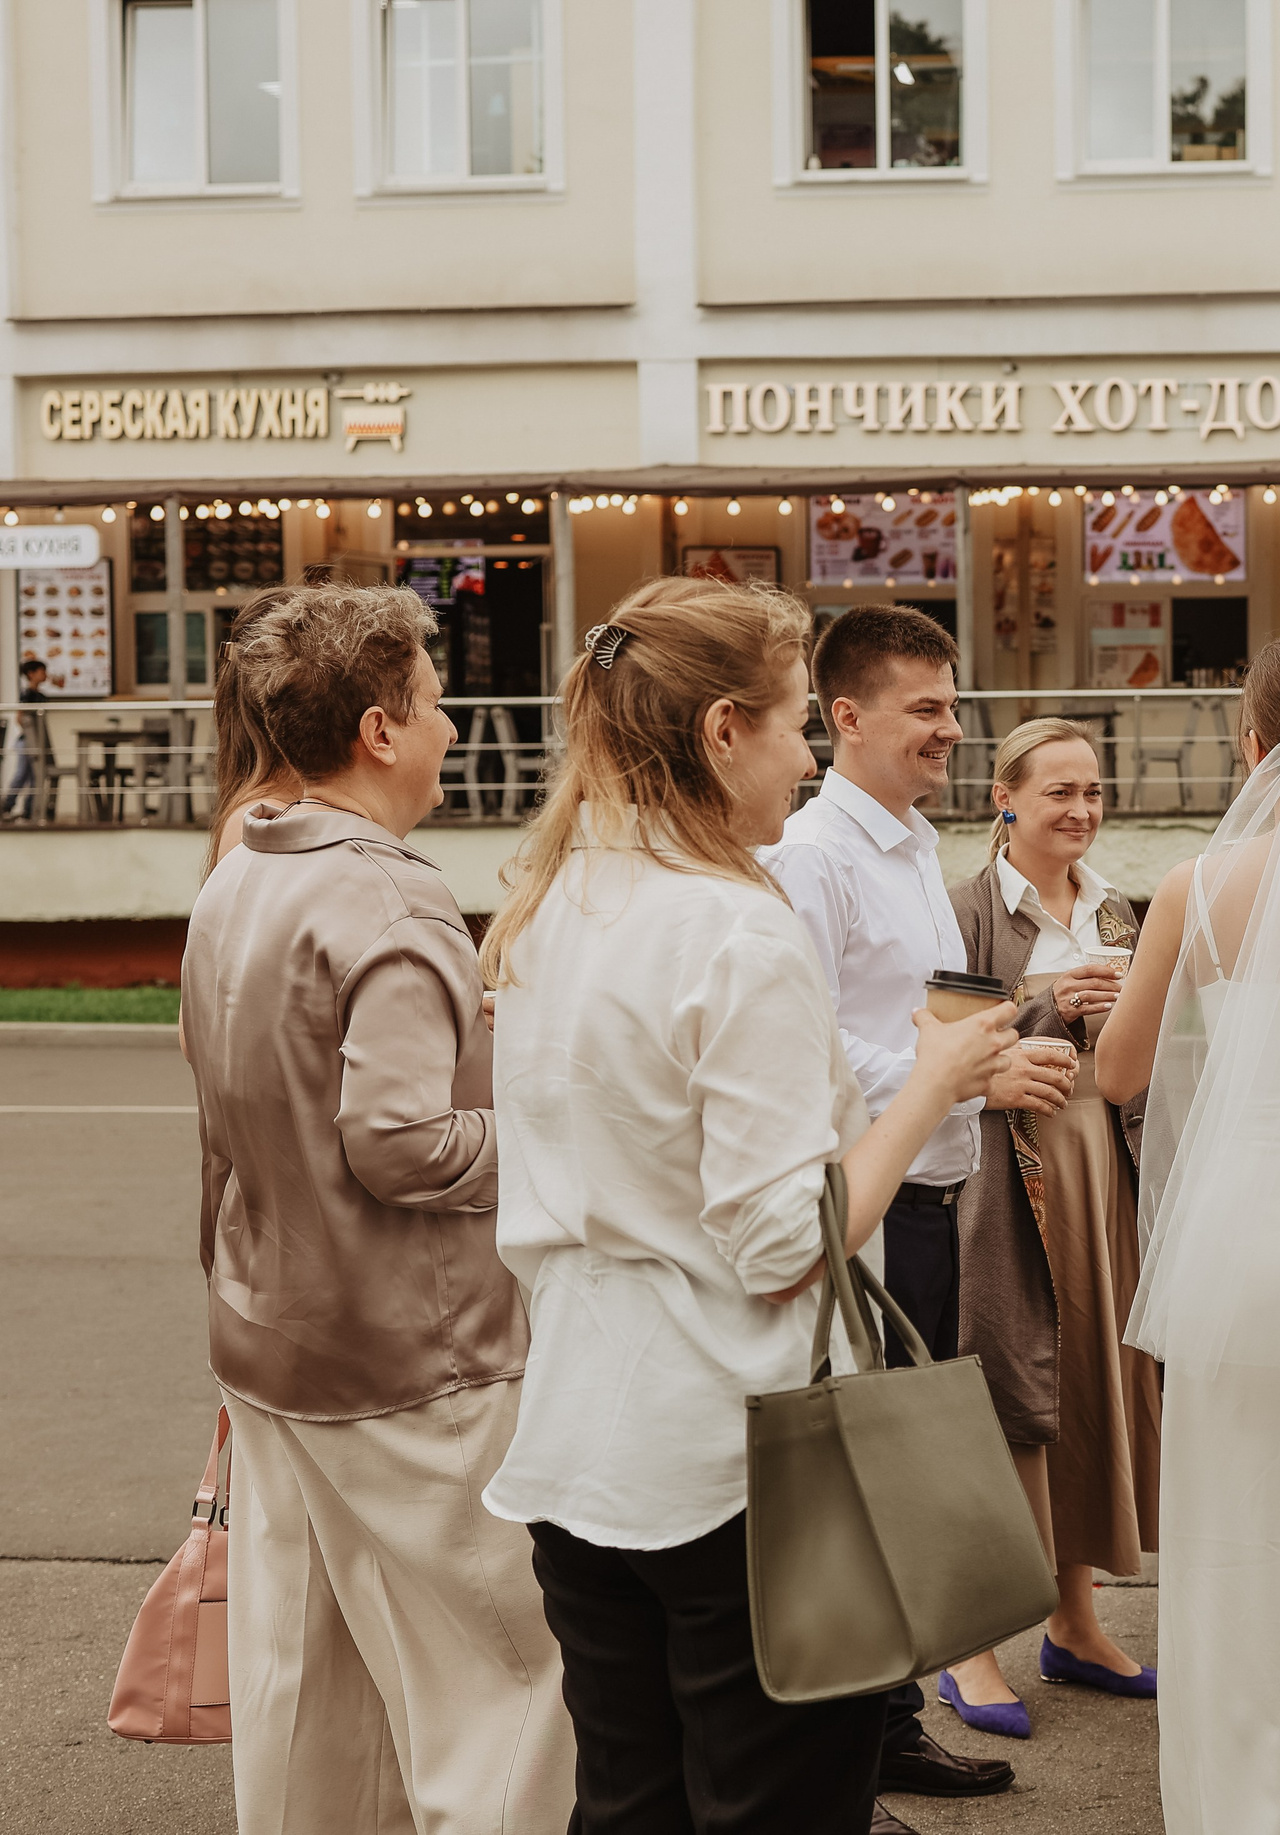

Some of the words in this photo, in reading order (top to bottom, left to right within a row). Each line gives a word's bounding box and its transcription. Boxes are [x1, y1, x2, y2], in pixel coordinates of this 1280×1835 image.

[40, 387, 208, 440] СЕРБСКАЯ
[214, 387, 330, 438] КУХНЯ
[705, 380, 1022, 434] ПОНЧИКИ
